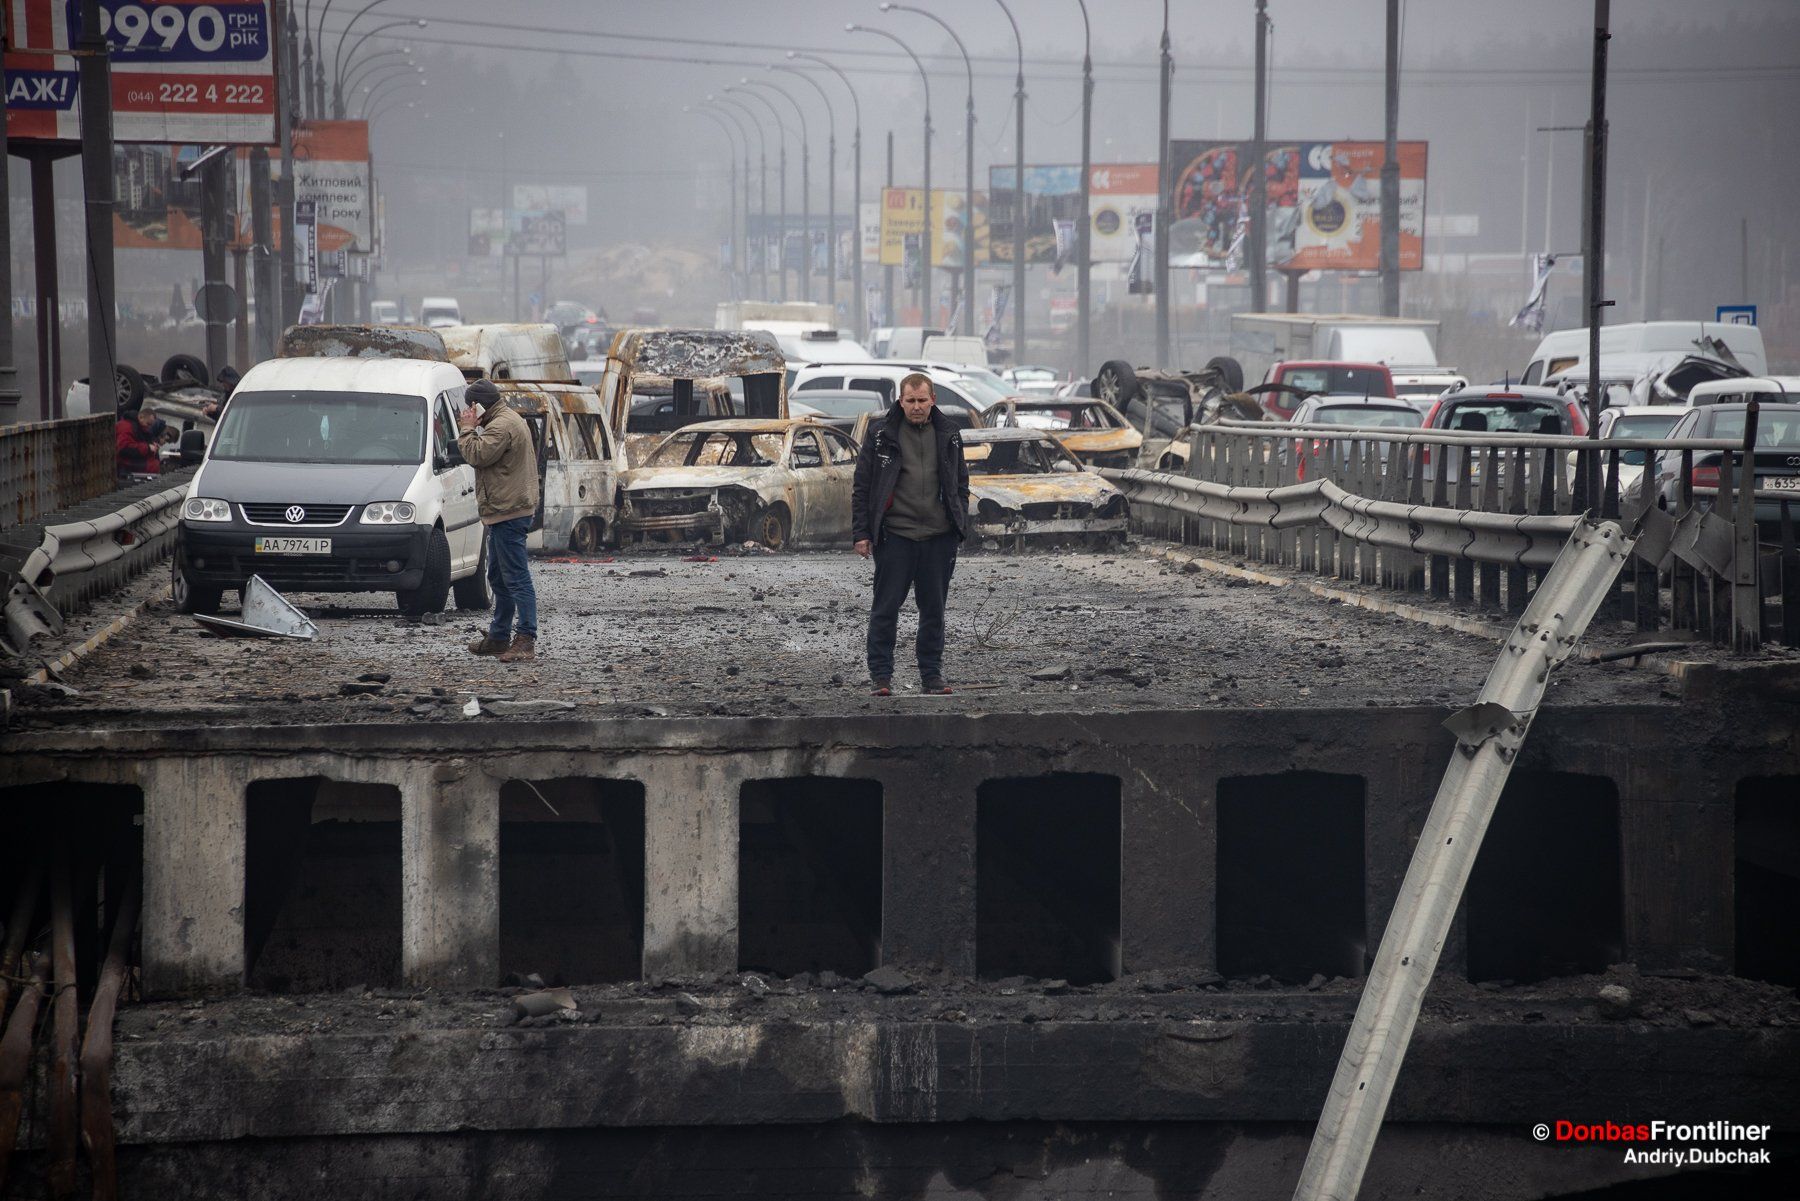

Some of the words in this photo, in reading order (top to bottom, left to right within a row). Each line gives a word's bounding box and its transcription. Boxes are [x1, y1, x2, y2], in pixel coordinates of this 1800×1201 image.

[228, 13, 259, 27] грн
[229, 30, 259, 48] рік
[127, 90, 154, 103] (044)
[159, 84, 198, 103] 222
[205, 85, 218, 103] 4
[225, 85, 264, 104] 222
[299, 174, 362, 187] Житловий
[298, 193, 357, 205] комплекс
[332, 210, 362, 225] року
[263, 539, 279, 551] AA
[282, 539, 309, 551] 7974
[315, 540, 329, 552] IP
